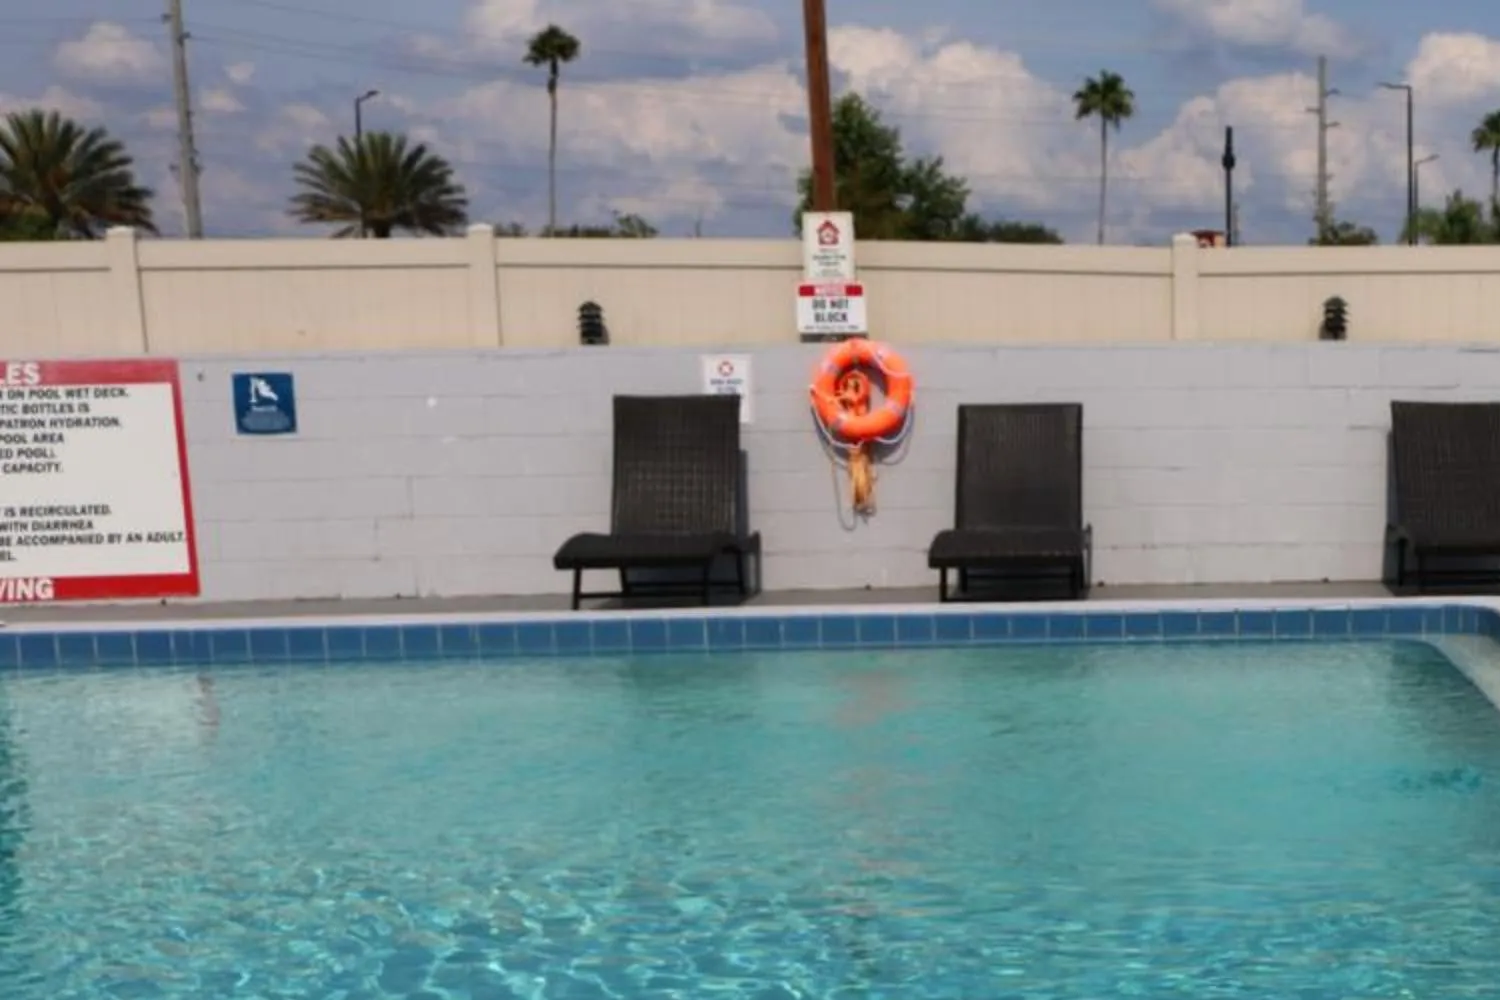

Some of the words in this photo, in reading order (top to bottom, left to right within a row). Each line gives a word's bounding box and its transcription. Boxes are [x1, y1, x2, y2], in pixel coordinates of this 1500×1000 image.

[814, 311, 849, 323] BLOCK
[8, 388, 24, 400] ON
[29, 387, 60, 400] POOL
[65, 387, 89, 399] WET
[22, 402, 74, 414] BOTTLES
[78, 402, 90, 413] IS
[33, 431, 65, 443] AREA
[4, 506, 16, 517] IS
[32, 519, 93, 531] DIARRHEA
[16, 533, 104, 546] ACCOMPANIED
[107, 533, 121, 545] BY
[126, 532, 143, 543] AN
